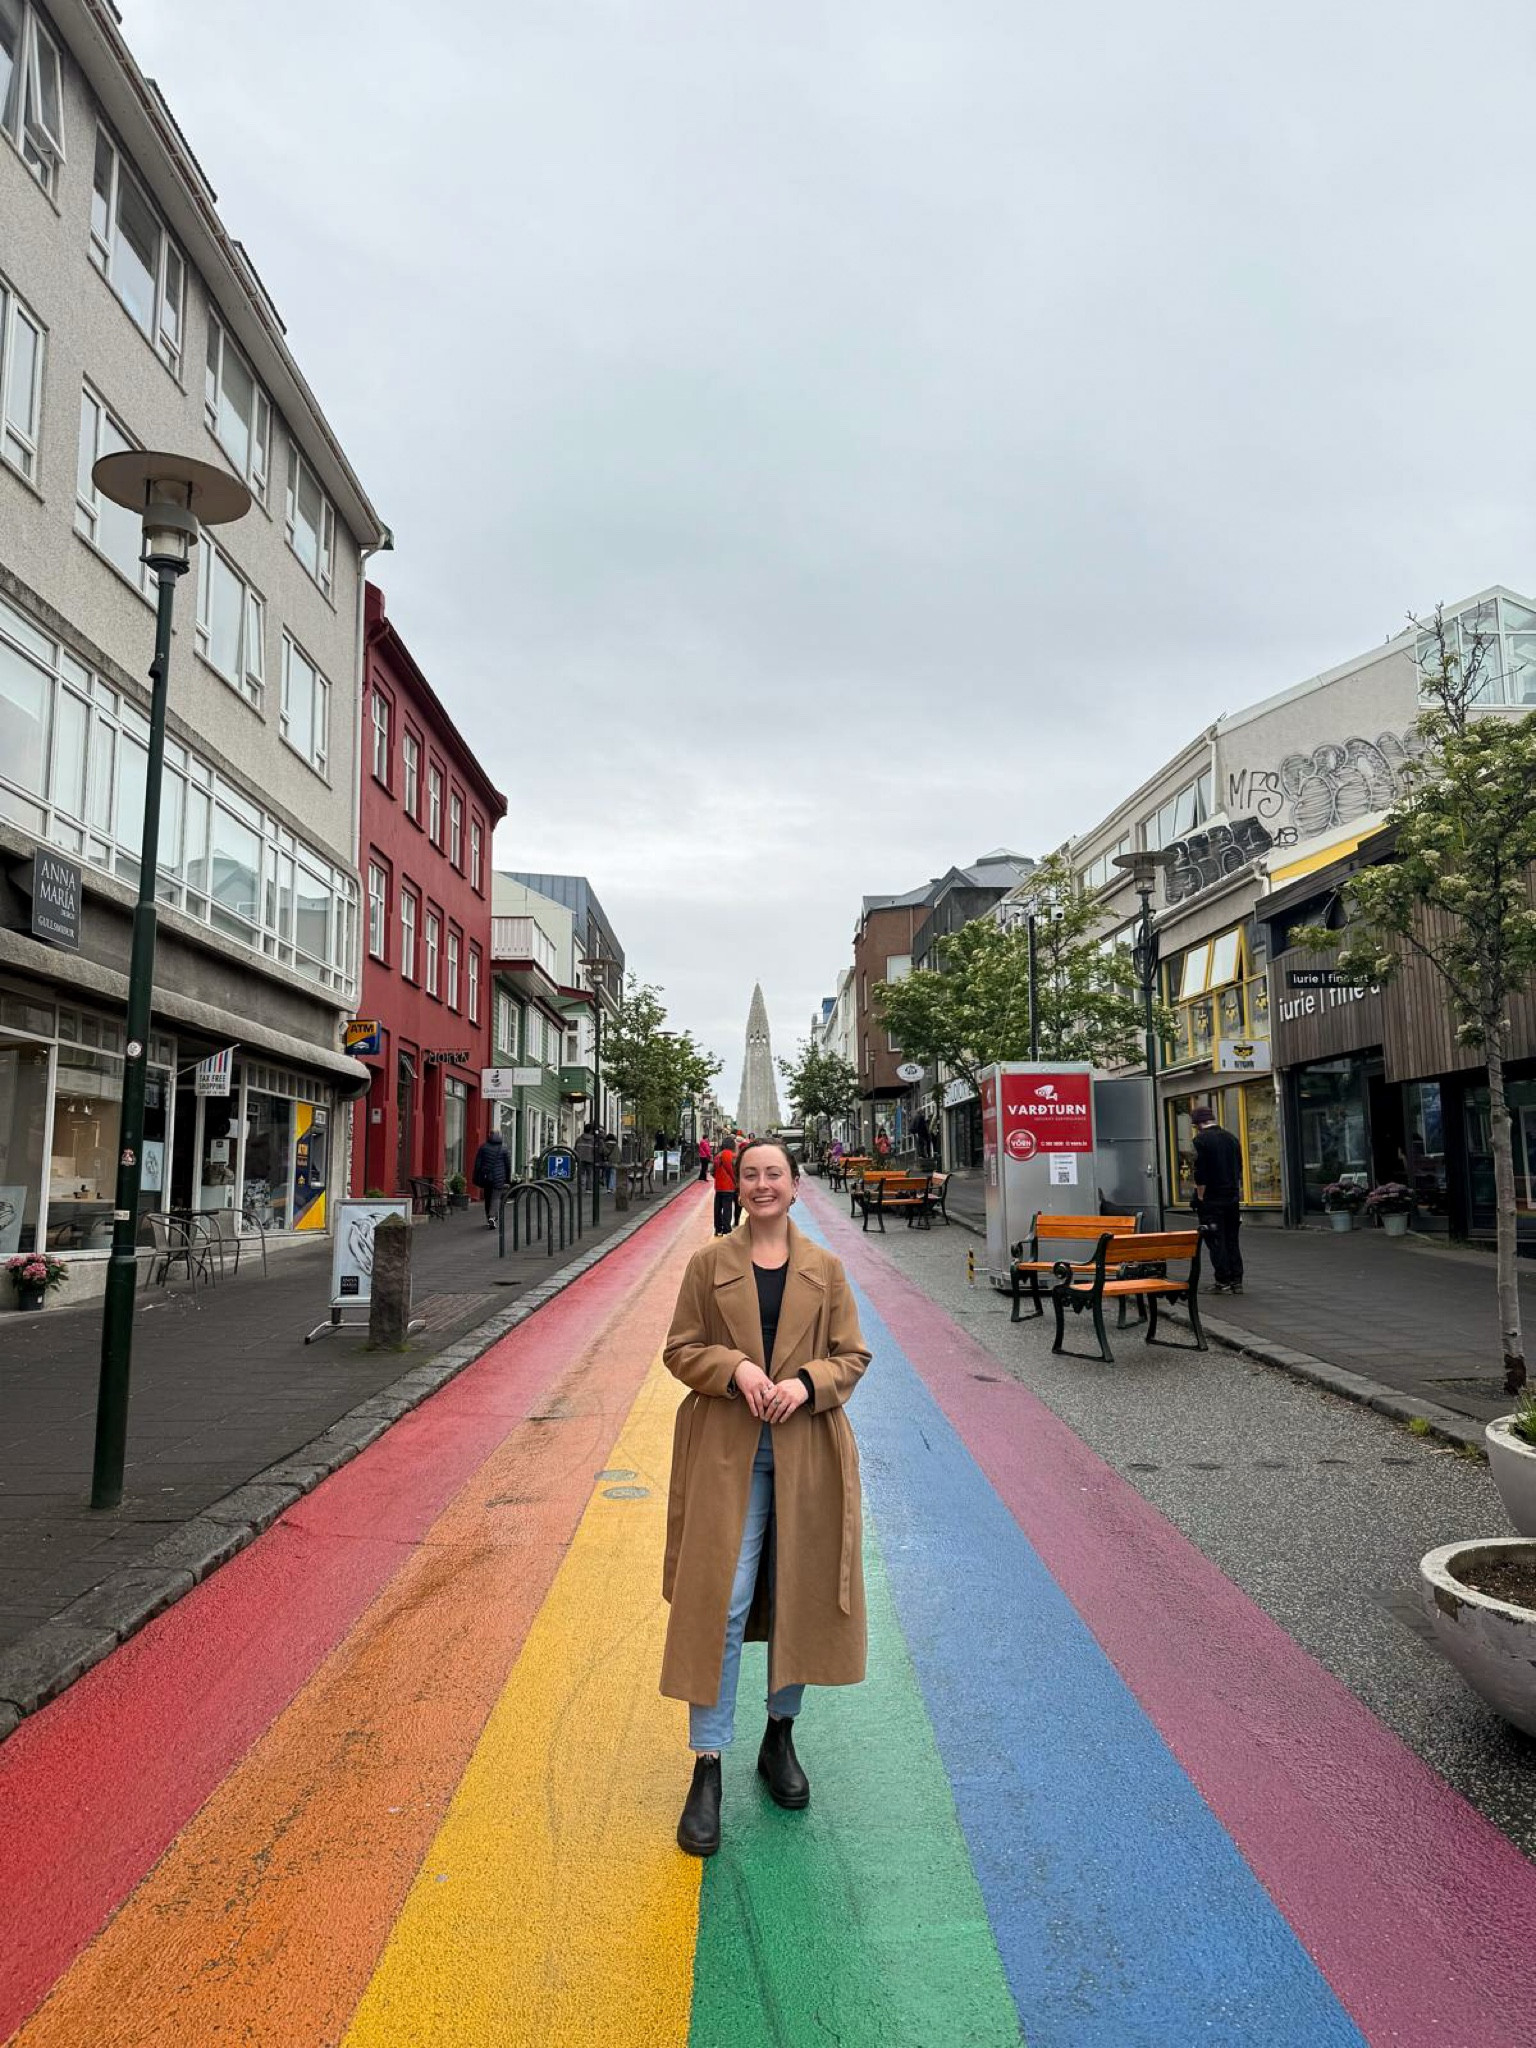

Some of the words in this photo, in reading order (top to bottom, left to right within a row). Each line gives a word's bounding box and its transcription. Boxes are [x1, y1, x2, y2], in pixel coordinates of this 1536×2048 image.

[41, 860, 75, 891] ANNA
[40, 881, 75, 912] MARÍA
[1279, 990, 1316, 1022] iurie
[350, 1023, 375, 1033] ATM
[1008, 1104, 1087, 1116] VARÐTURN
[555, 1157, 564, 1168] P
